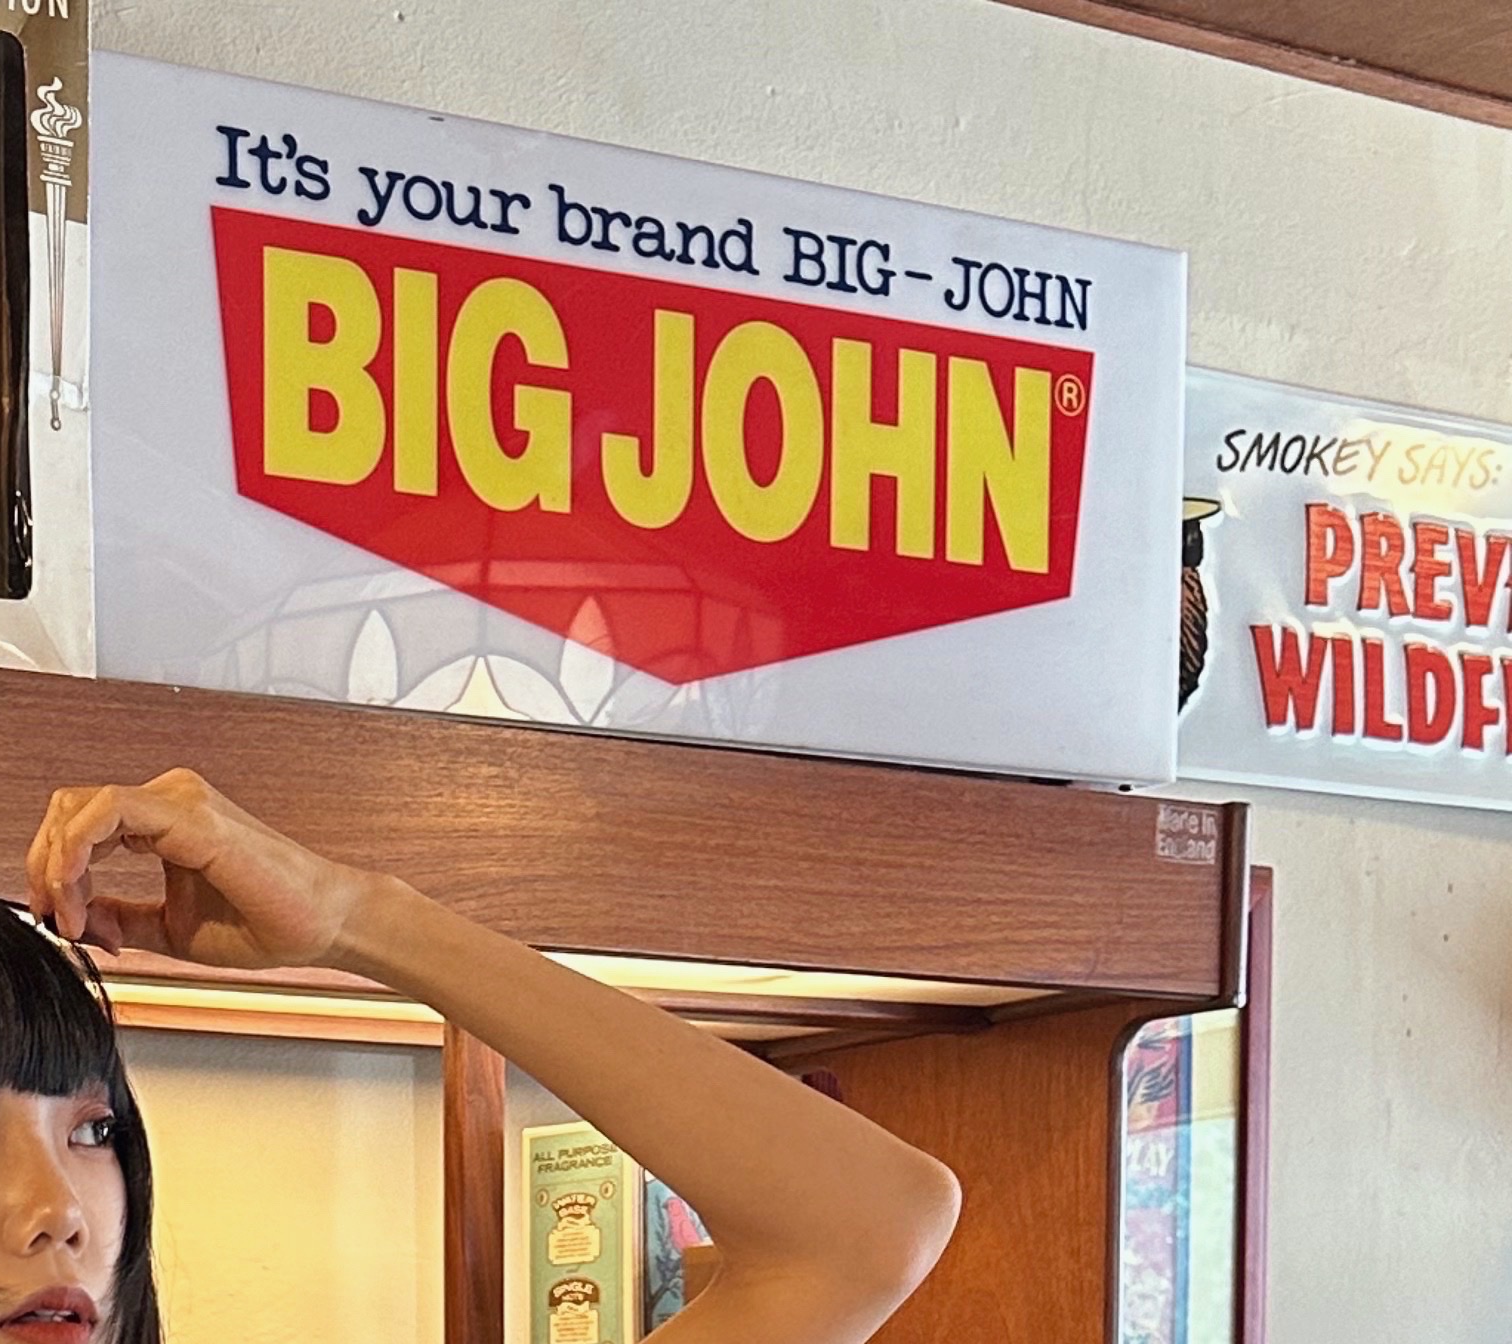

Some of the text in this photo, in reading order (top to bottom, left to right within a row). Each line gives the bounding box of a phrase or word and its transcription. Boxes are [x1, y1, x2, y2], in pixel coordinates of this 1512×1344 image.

[214, 125, 332, 201] It's
[357, 165, 533, 234] your
[548, 184, 760, 276] brand
[260, 245, 574, 517] BIG
[600, 308, 1052, 574] JOHN
[1217, 428, 1504, 491] SMOKEY SAYS:
[1303, 501, 1512, 627] PREV
[538, 1155, 613, 1175] FRAGRANCE
